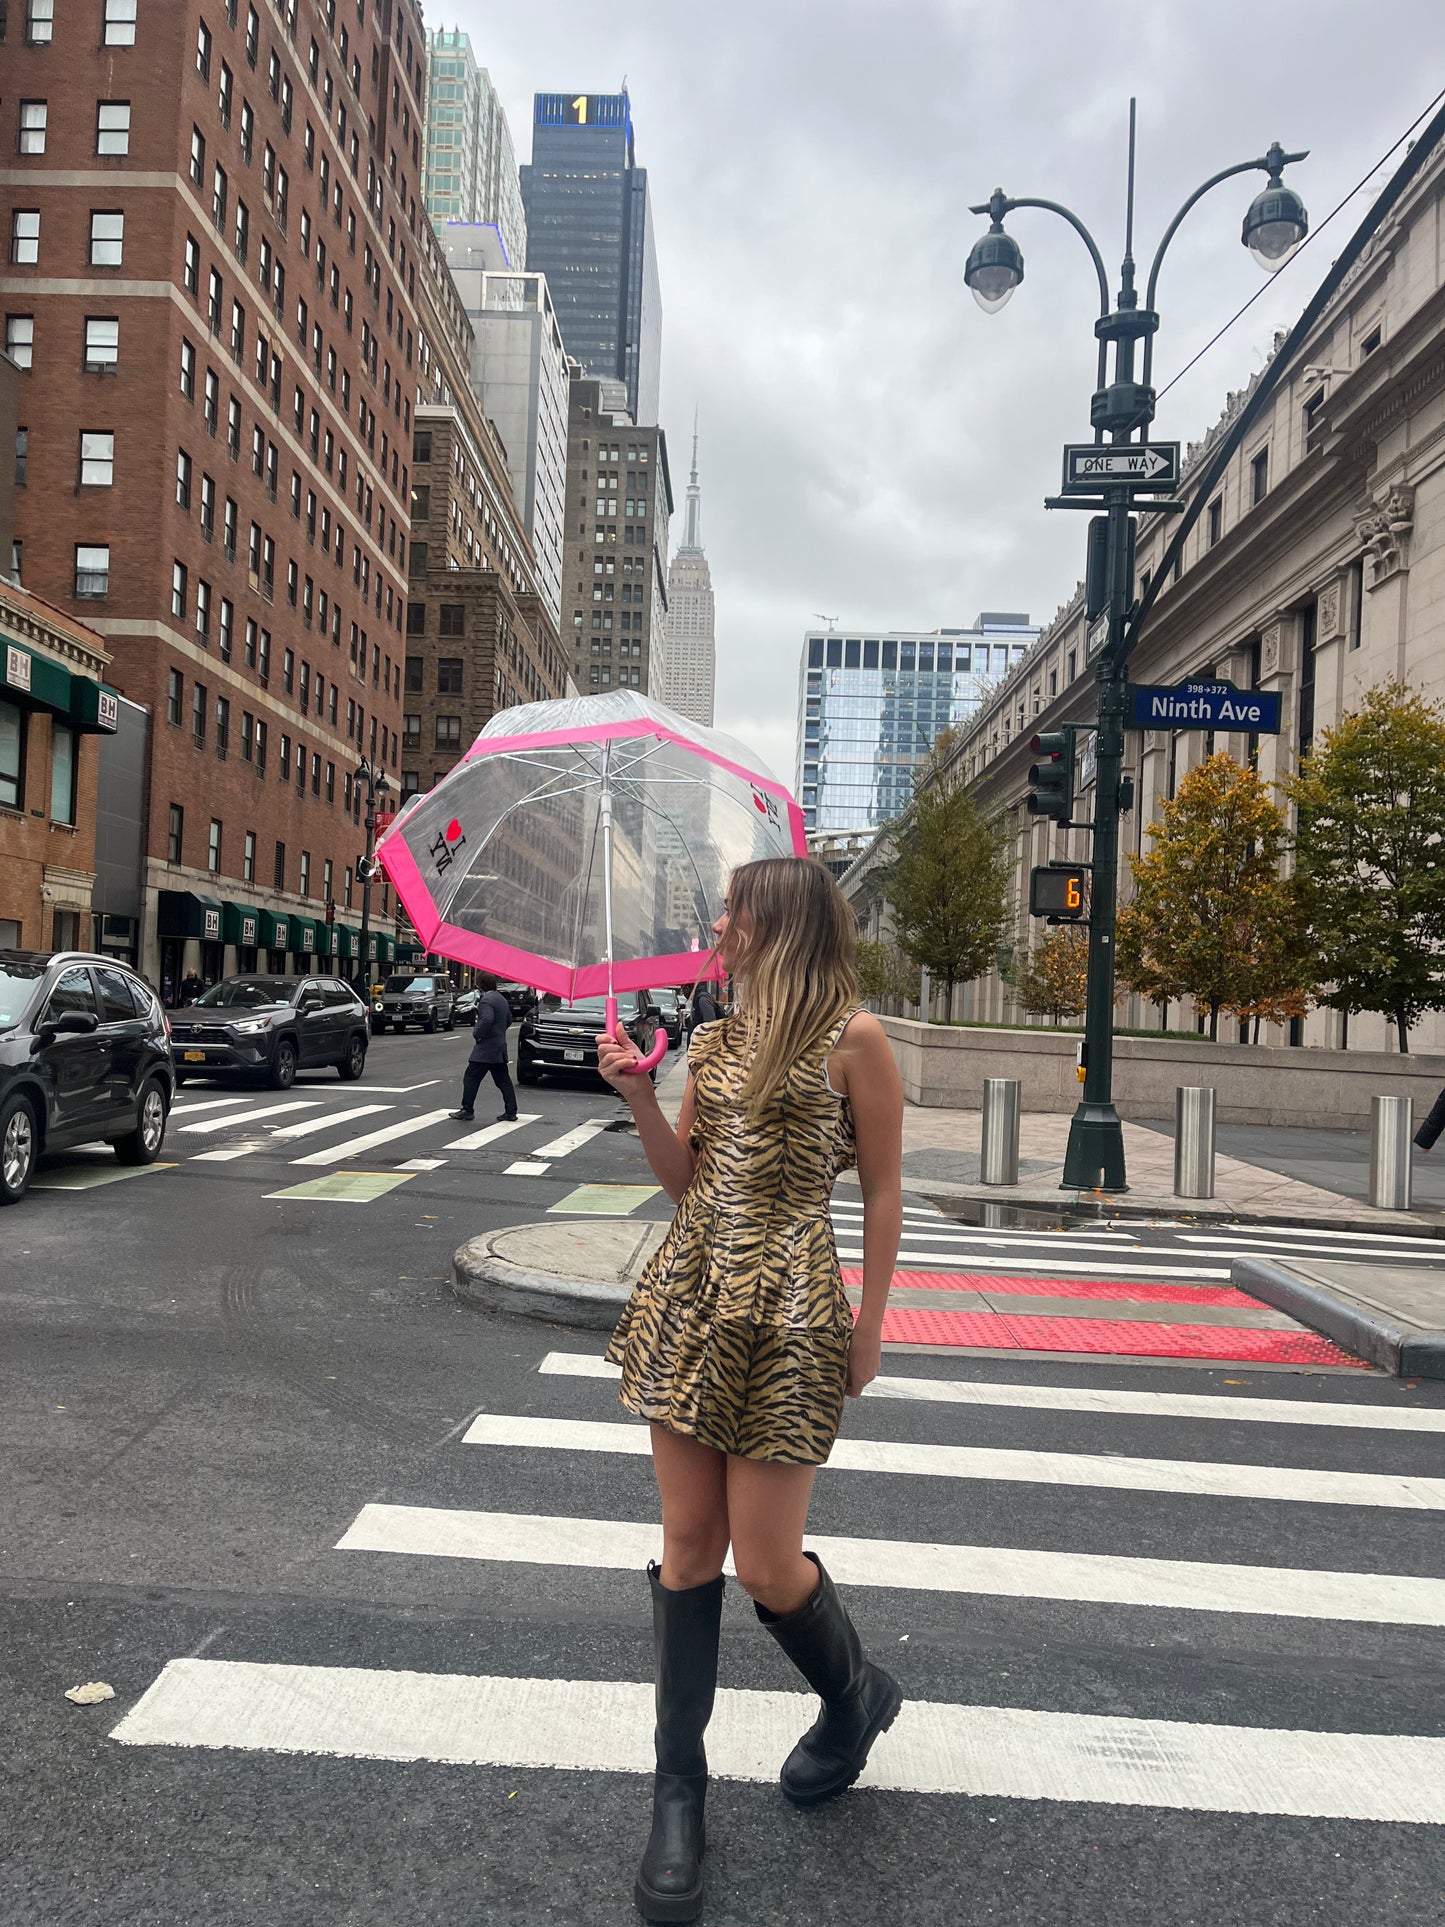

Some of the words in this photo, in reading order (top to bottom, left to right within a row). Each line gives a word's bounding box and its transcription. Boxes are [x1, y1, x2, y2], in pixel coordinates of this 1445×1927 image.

[572, 96, 587, 124] 1
[1085, 459, 1114, 472] ONE
[1128, 457, 1158, 470] WAY
[1187, 684, 1204, 694] 398
[1212, 685, 1228, 695] 372
[101, 696, 116, 718] BH
[1152, 696, 1212, 719] Ninth
[1218, 700, 1261, 722] Ave
[1067, 878, 1081, 908] 6
[207, 914, 218, 931] BH
[244, 920, 254, 936] BH
[277, 926, 287, 940] BH
